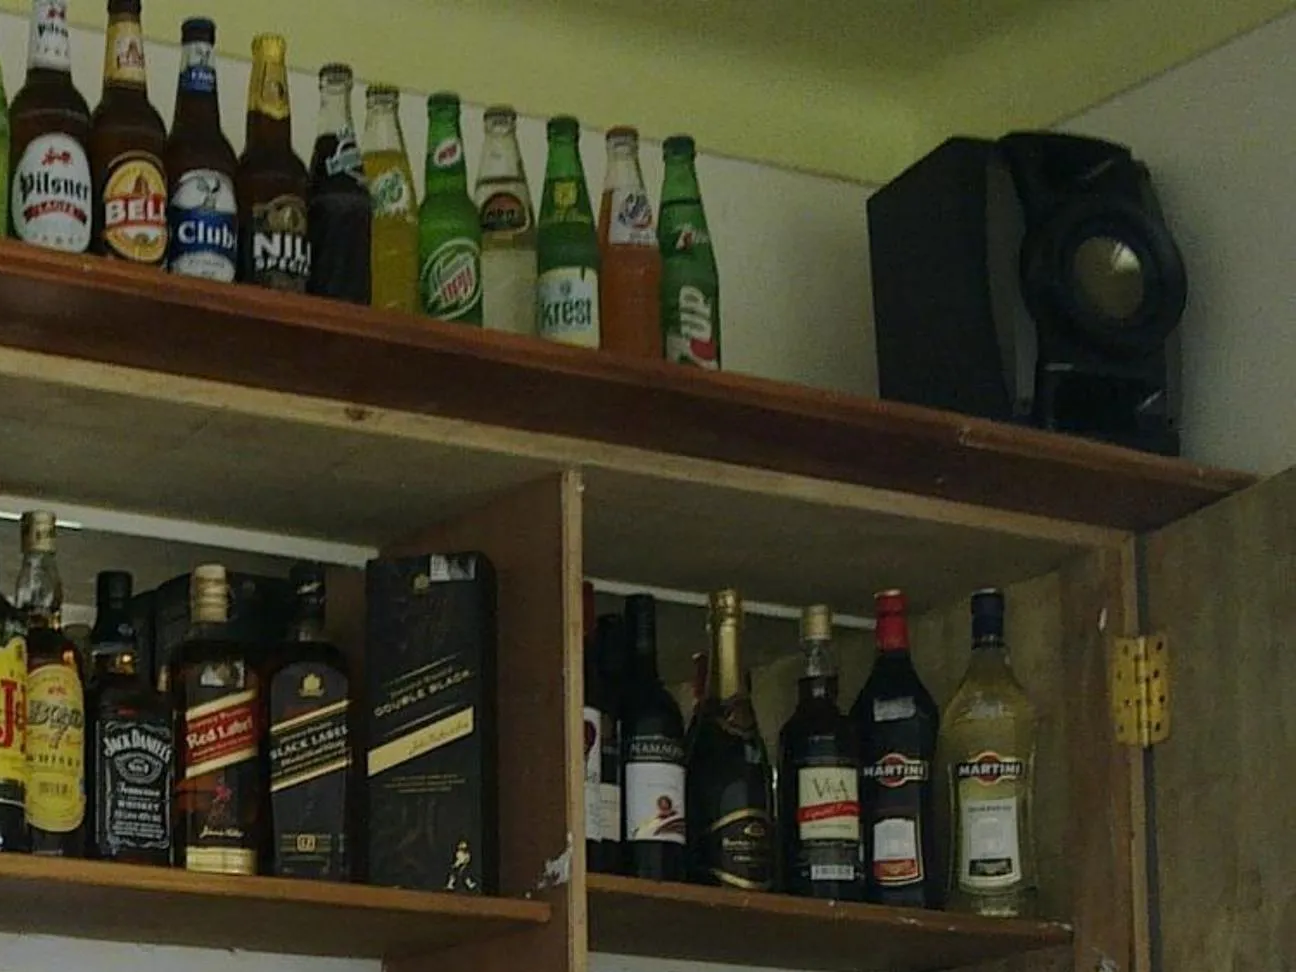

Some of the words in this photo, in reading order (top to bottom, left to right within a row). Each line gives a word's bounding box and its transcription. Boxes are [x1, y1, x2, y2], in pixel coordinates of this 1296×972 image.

[20, 171, 89, 204] Pilsner
[177, 219, 237, 250] Club
[185, 727, 218, 750] Red
[863, 762, 925, 778] MARTINI
[958, 761, 1022, 779] MARTINI
